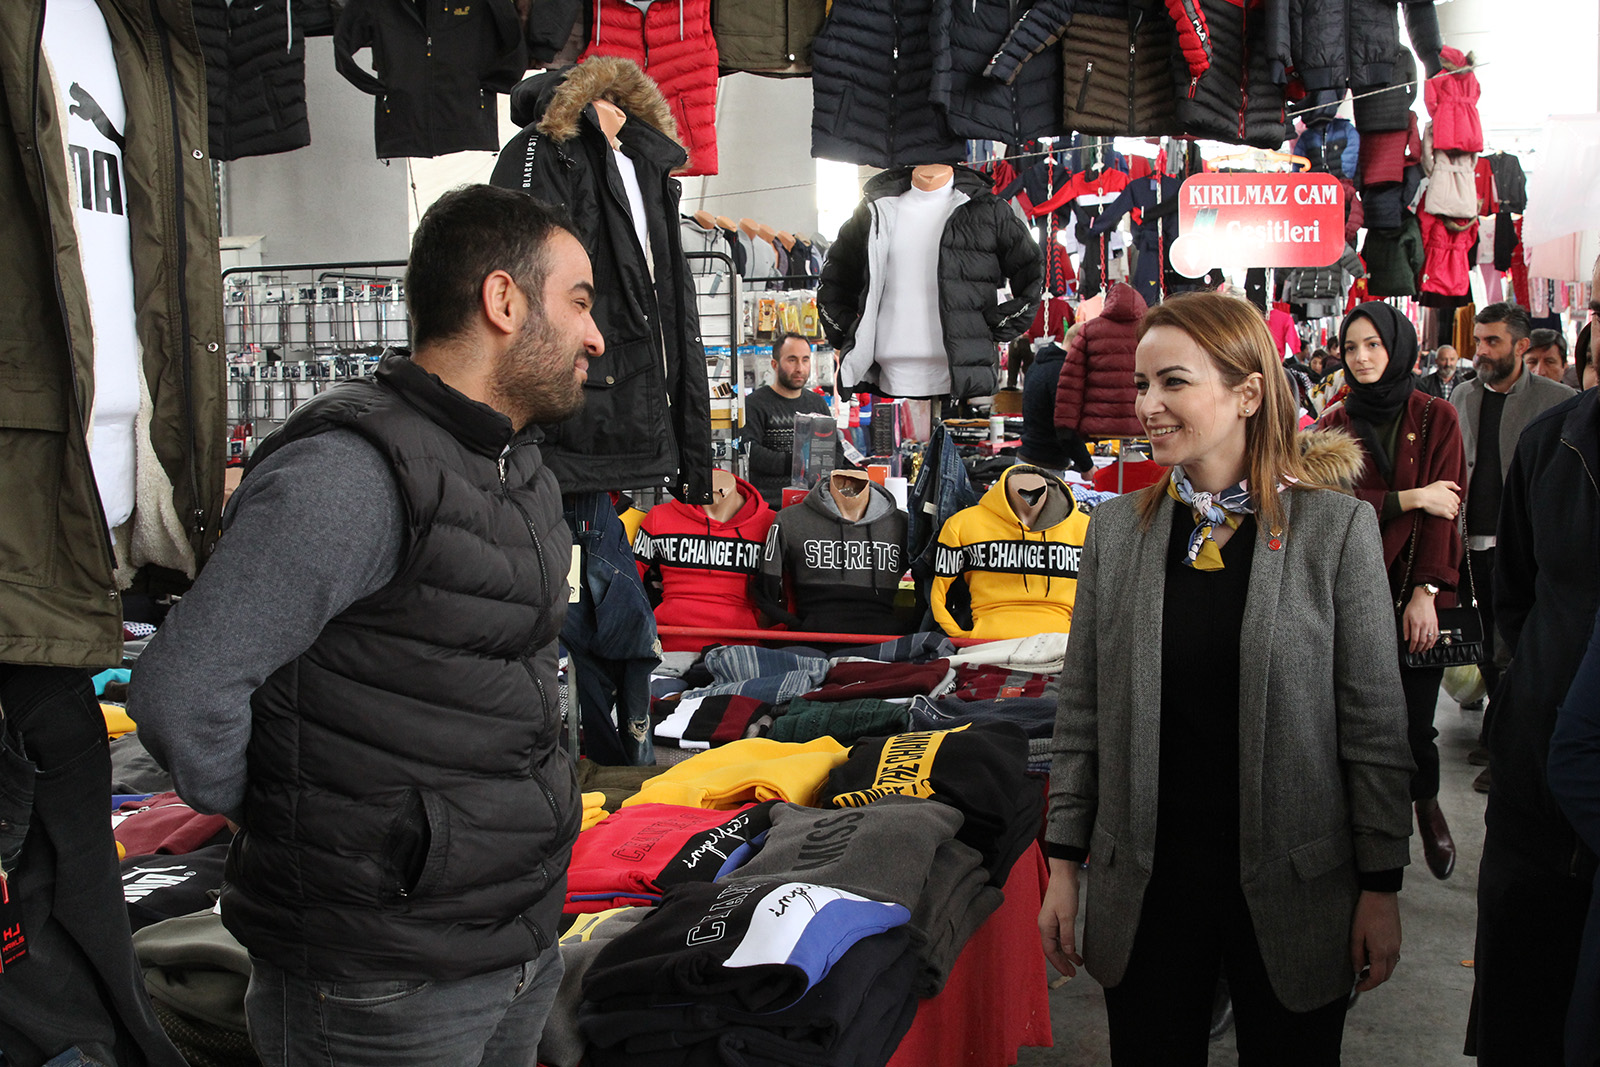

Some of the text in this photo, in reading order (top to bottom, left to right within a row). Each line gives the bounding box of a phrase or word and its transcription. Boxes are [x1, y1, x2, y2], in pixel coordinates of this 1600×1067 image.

[1189, 184, 1338, 205] KIRILMAZ CAM
[655, 537, 679, 562] THE
[679, 537, 734, 566] CHANGE
[803, 539, 901, 573] SECRETS
[988, 542, 1046, 569] CHANGE
